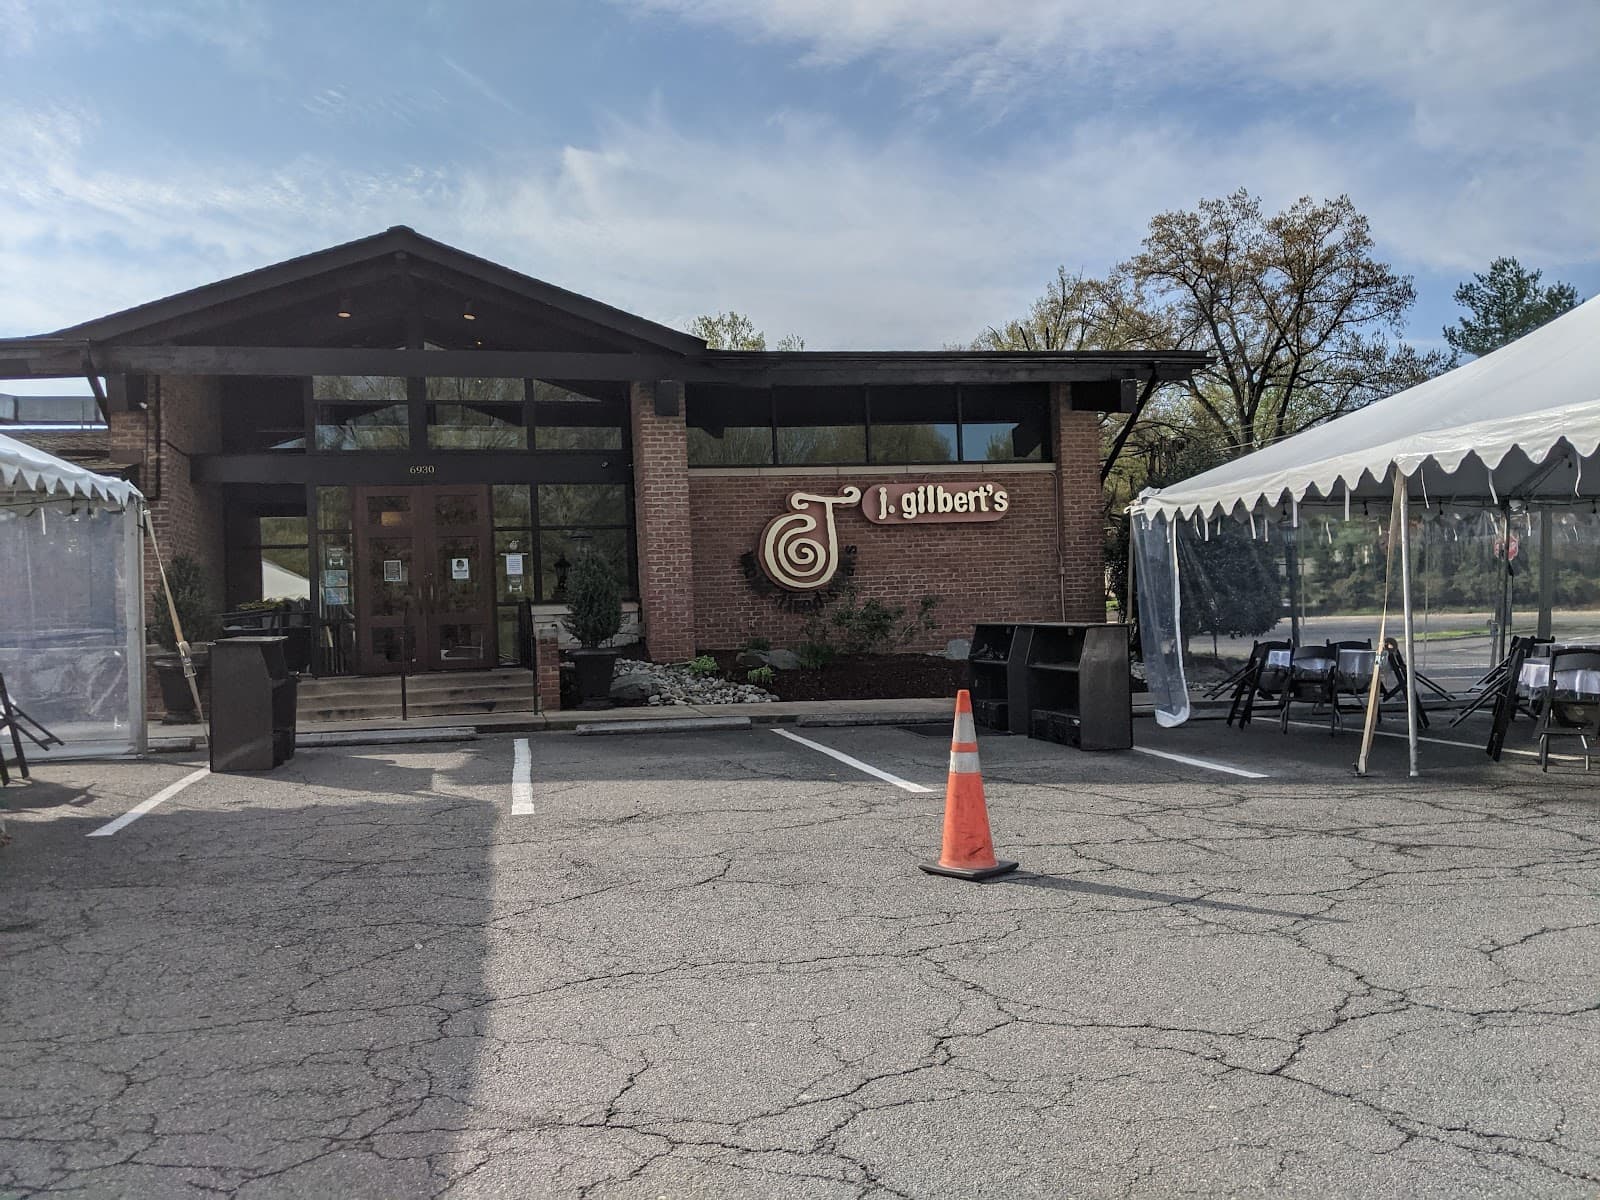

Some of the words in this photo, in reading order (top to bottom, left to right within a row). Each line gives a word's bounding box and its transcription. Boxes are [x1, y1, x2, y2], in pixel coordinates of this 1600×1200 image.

[409, 464, 436, 474] 6930
[878, 486, 896, 520] j.
[901, 484, 1009, 519] gilbert's
